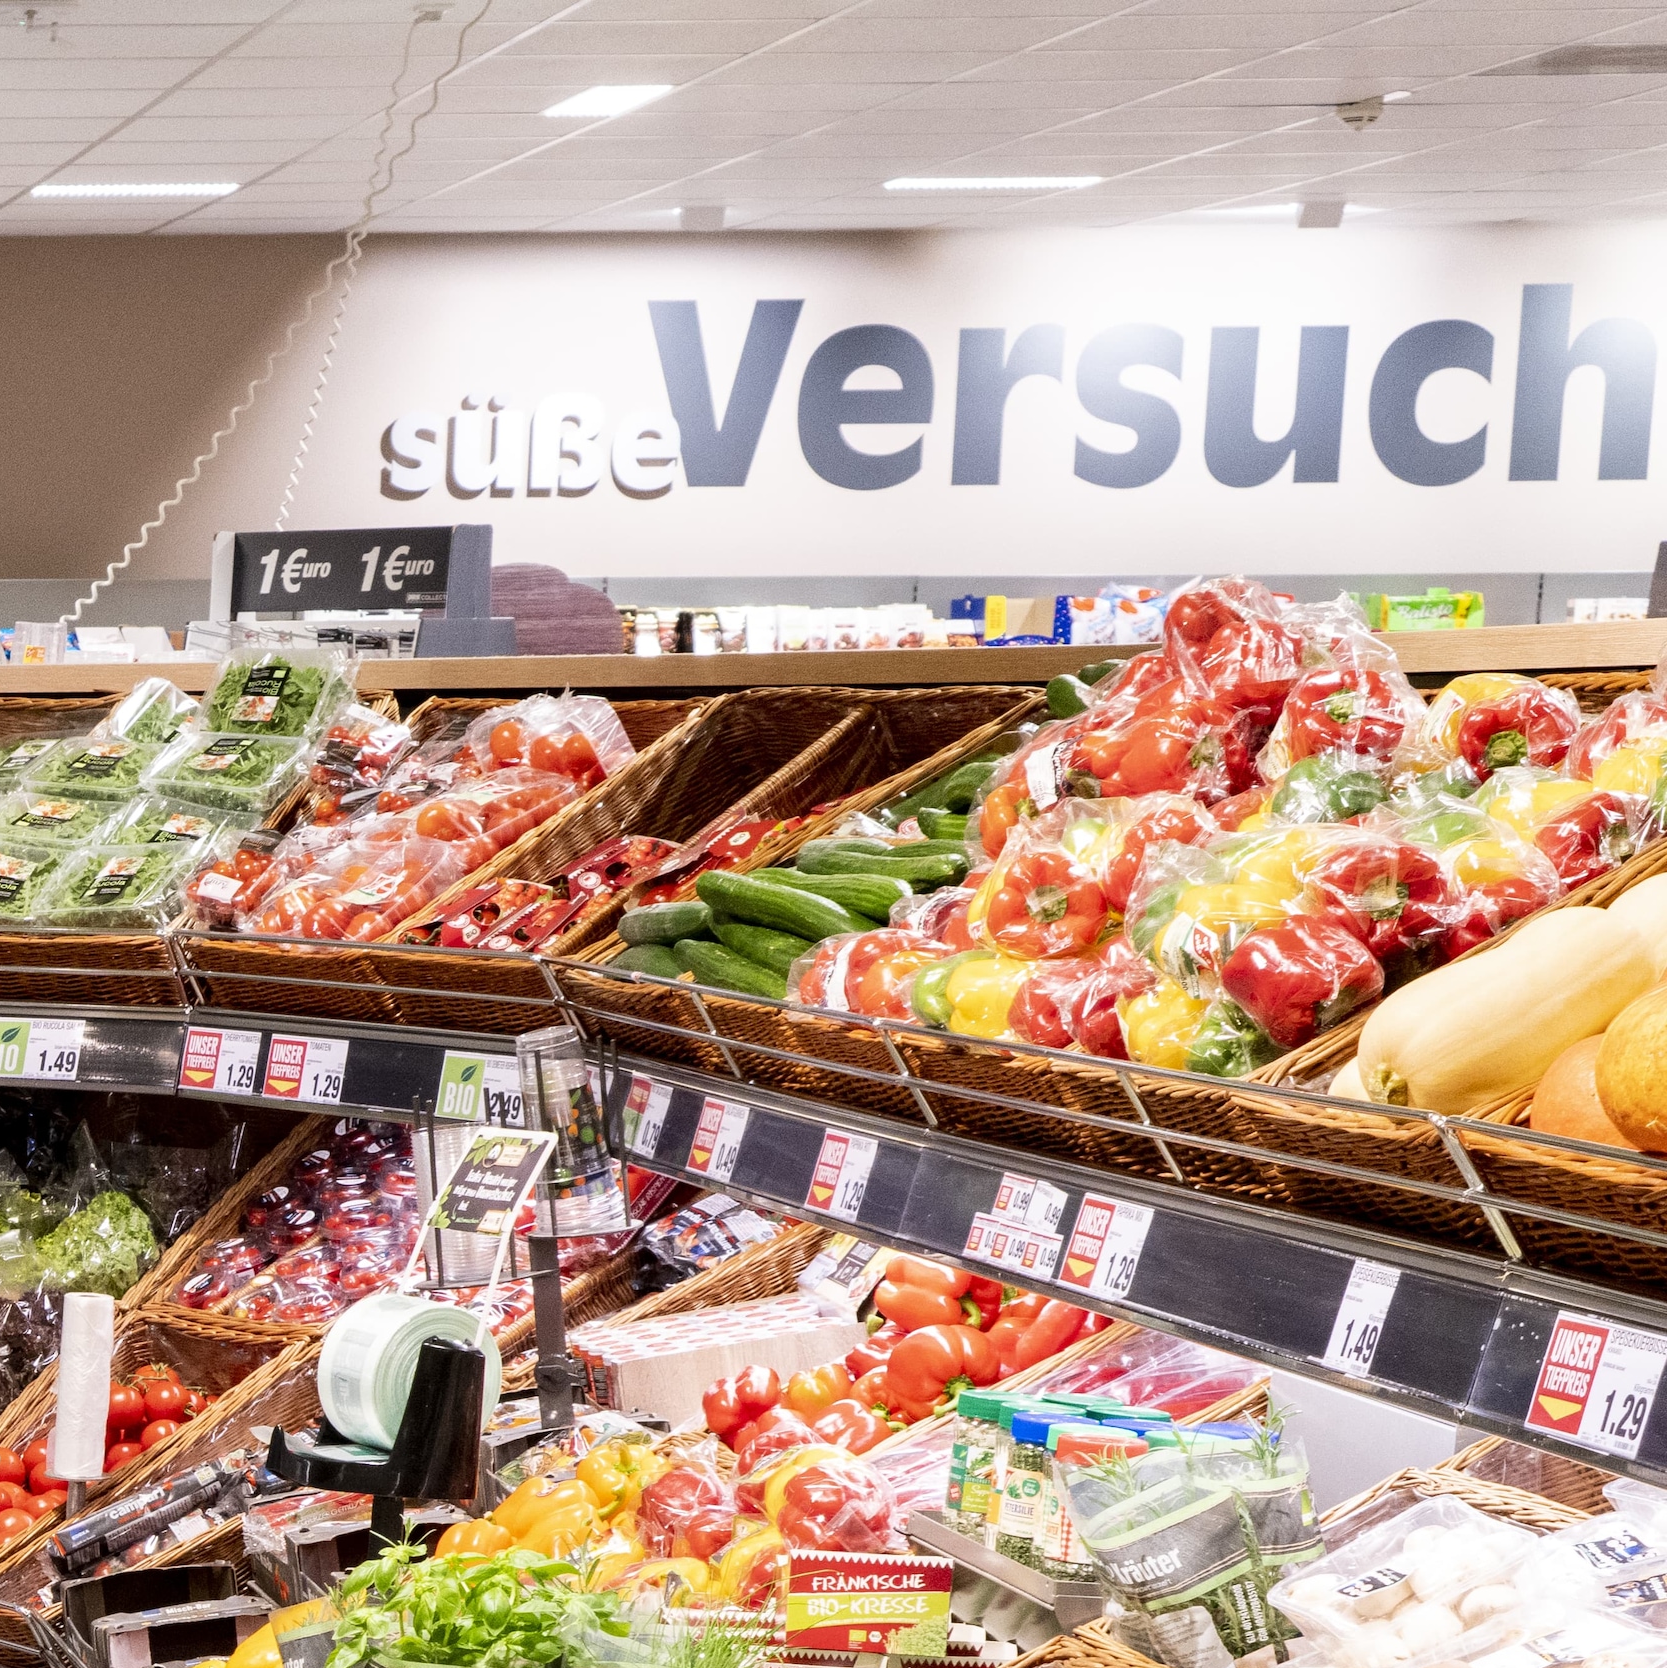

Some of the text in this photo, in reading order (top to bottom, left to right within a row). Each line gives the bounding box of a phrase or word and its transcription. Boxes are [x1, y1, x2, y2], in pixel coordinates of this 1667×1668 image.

[380, 393, 679, 499] süße
[188, 1032, 218, 1054] UNSER
[272, 1042, 304, 1064] UNSER
[310, 1041, 333, 1052] TOMATEN
[40, 1051, 76, 1072] 1.49
[186, 1054, 216, 1069] TIEFPREIS
[269, 1062, 301, 1078] TIEFPREIS
[228, 1065, 253, 1088] 1.29
[313, 1074, 340, 1098] 1.29
[444, 1081, 476, 1117] BIO
[715, 1142, 738, 1174] 0.49
[820, 1138, 844, 1167] UNSER
[839, 1179, 865, 1212] 1.29
[1043, 1203, 1062, 1226] 0.99
[1077, 1204, 1112, 1237] UNSER
[1039, 1247, 1058, 1268] 0.99
[1105, 1255, 1134, 1291] 1.29
[1341, 1320, 1378, 1363] 1.49
[1550, 1328, 1602, 1372] UNSER
[1542, 1365, 1591, 1399] TIEFPREIS
[1601, 1390, 1647, 1440] 1.29
[110, 1487, 166, 1520] campari
[1116, 1547, 1183, 1587] Kräuter
[811, 1572, 927, 1592] FRÄNKISCHE
[807, 1596, 930, 1617] BIO-KRESSE
